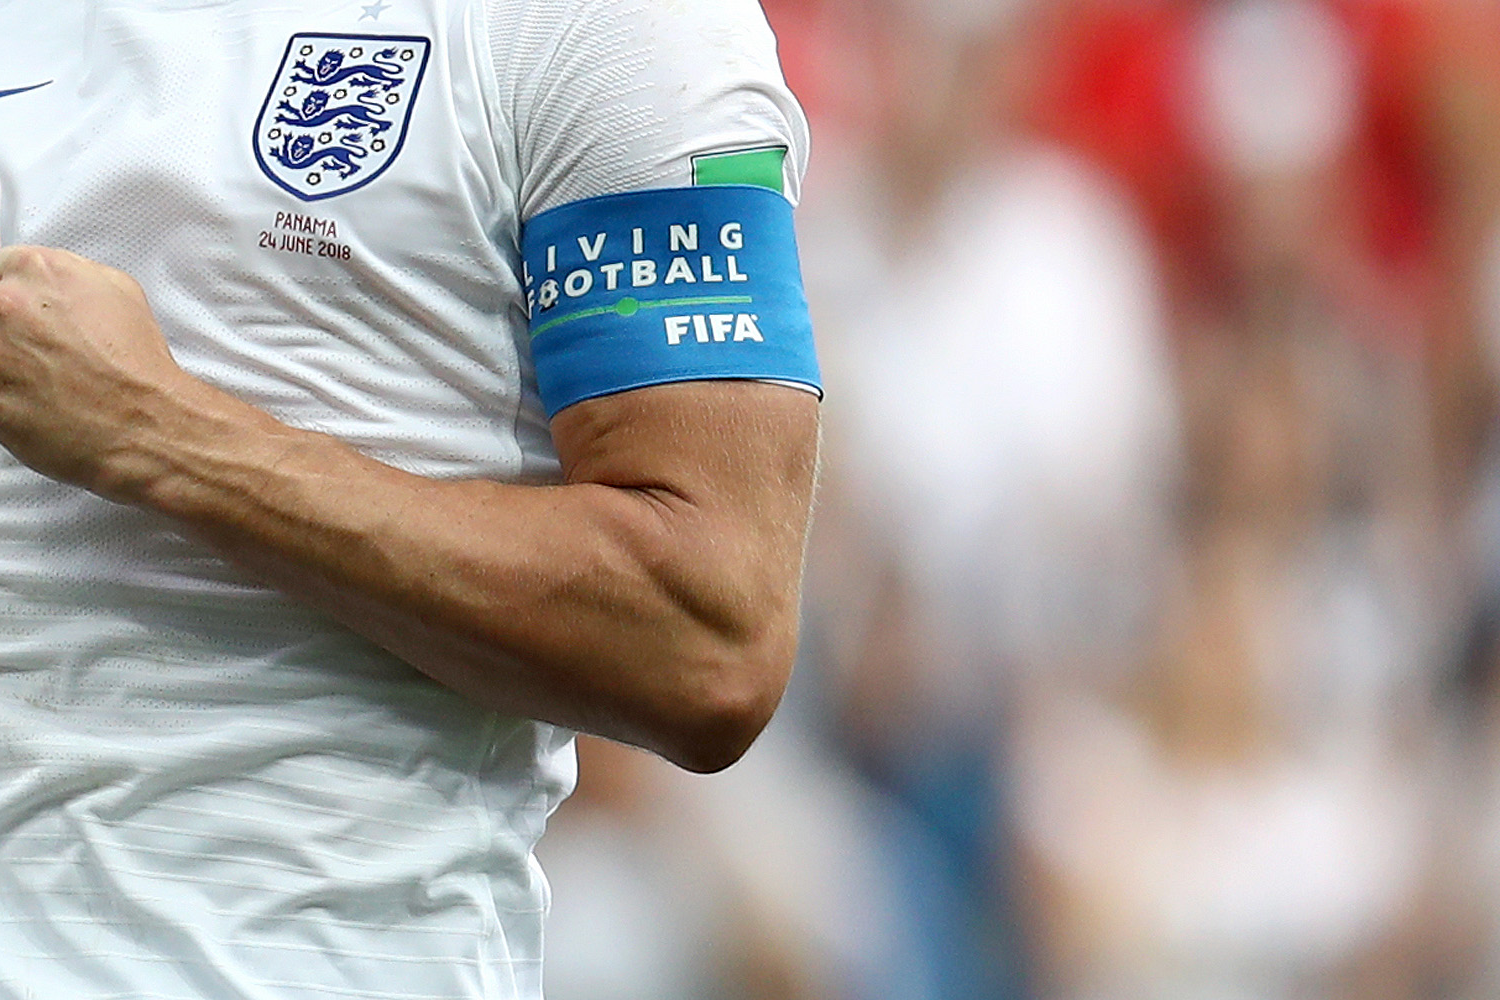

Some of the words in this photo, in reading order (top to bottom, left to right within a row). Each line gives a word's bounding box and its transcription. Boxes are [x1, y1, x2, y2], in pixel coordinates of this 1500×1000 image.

[274, 211, 337, 238] PANAMA
[259, 231, 276, 249] 24
[280, 234, 313, 255] JUNE
[318, 241, 351, 261] 2018
[523, 222, 744, 288] LIVING
[664, 314, 764, 345] FIFA
